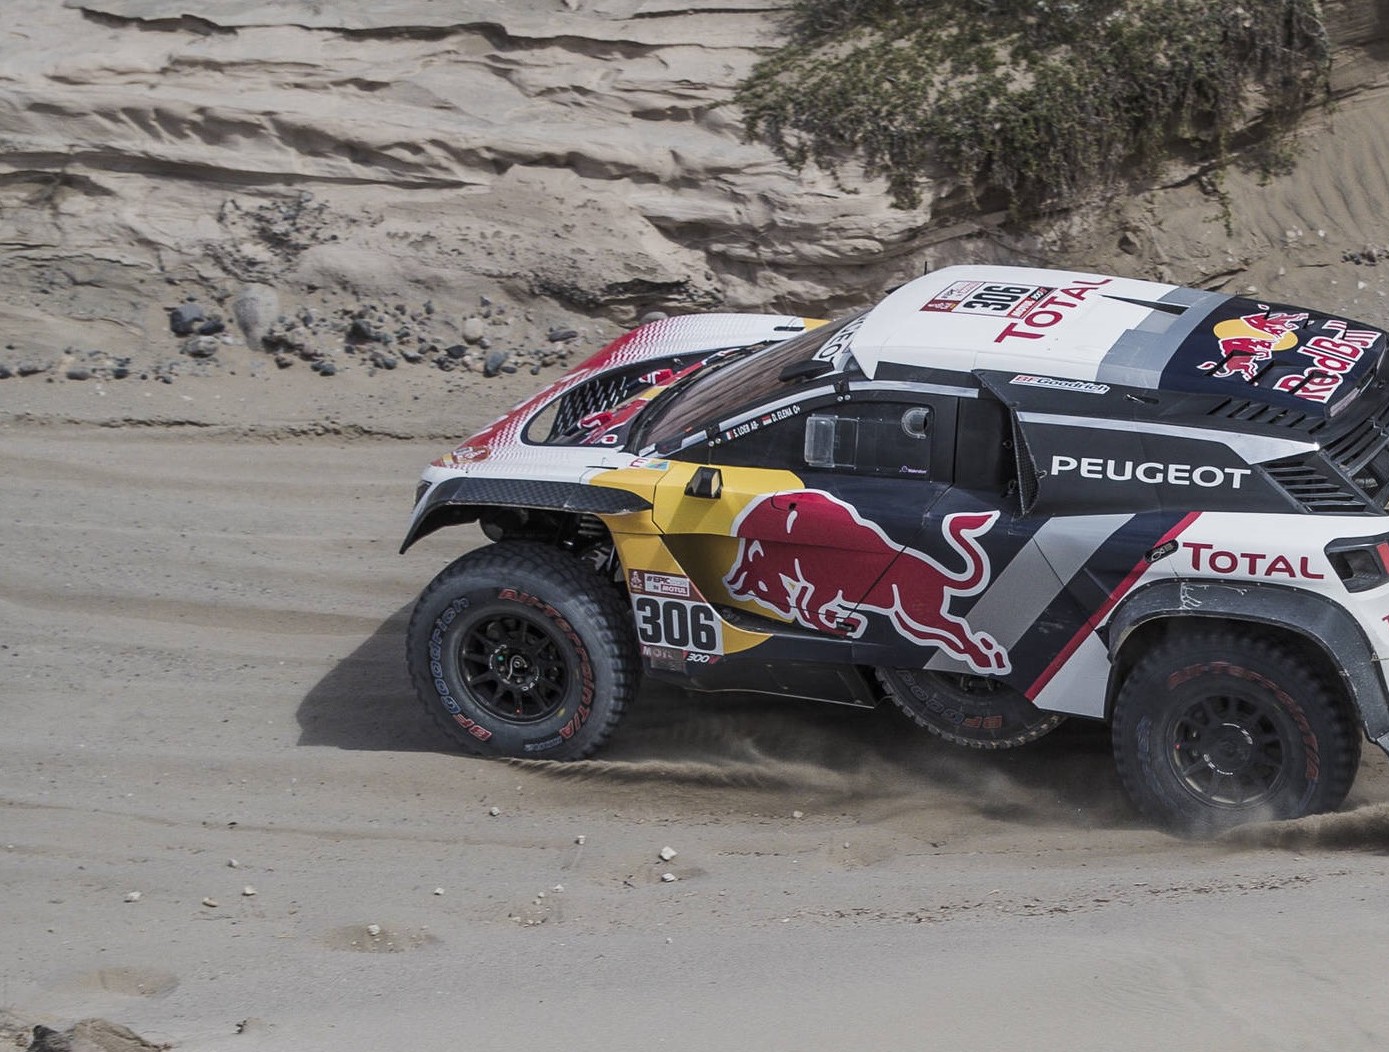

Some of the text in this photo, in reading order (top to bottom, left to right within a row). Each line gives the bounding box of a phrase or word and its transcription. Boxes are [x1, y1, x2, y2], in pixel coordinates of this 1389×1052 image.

[963, 285, 1031, 311] 306
[994, 278, 1113, 343] TOTAL
[1015, 375, 1108, 393] BFGoodrich
[777, 408, 792, 419] ELENA
[739, 424, 750, 435] LOEB
[1051, 455, 1251, 489] PEUGEOT
[1182, 542, 1324, 579] TOTAL
[662, 584, 687, 594] MOTUL
[636, 597, 717, 651] 306
